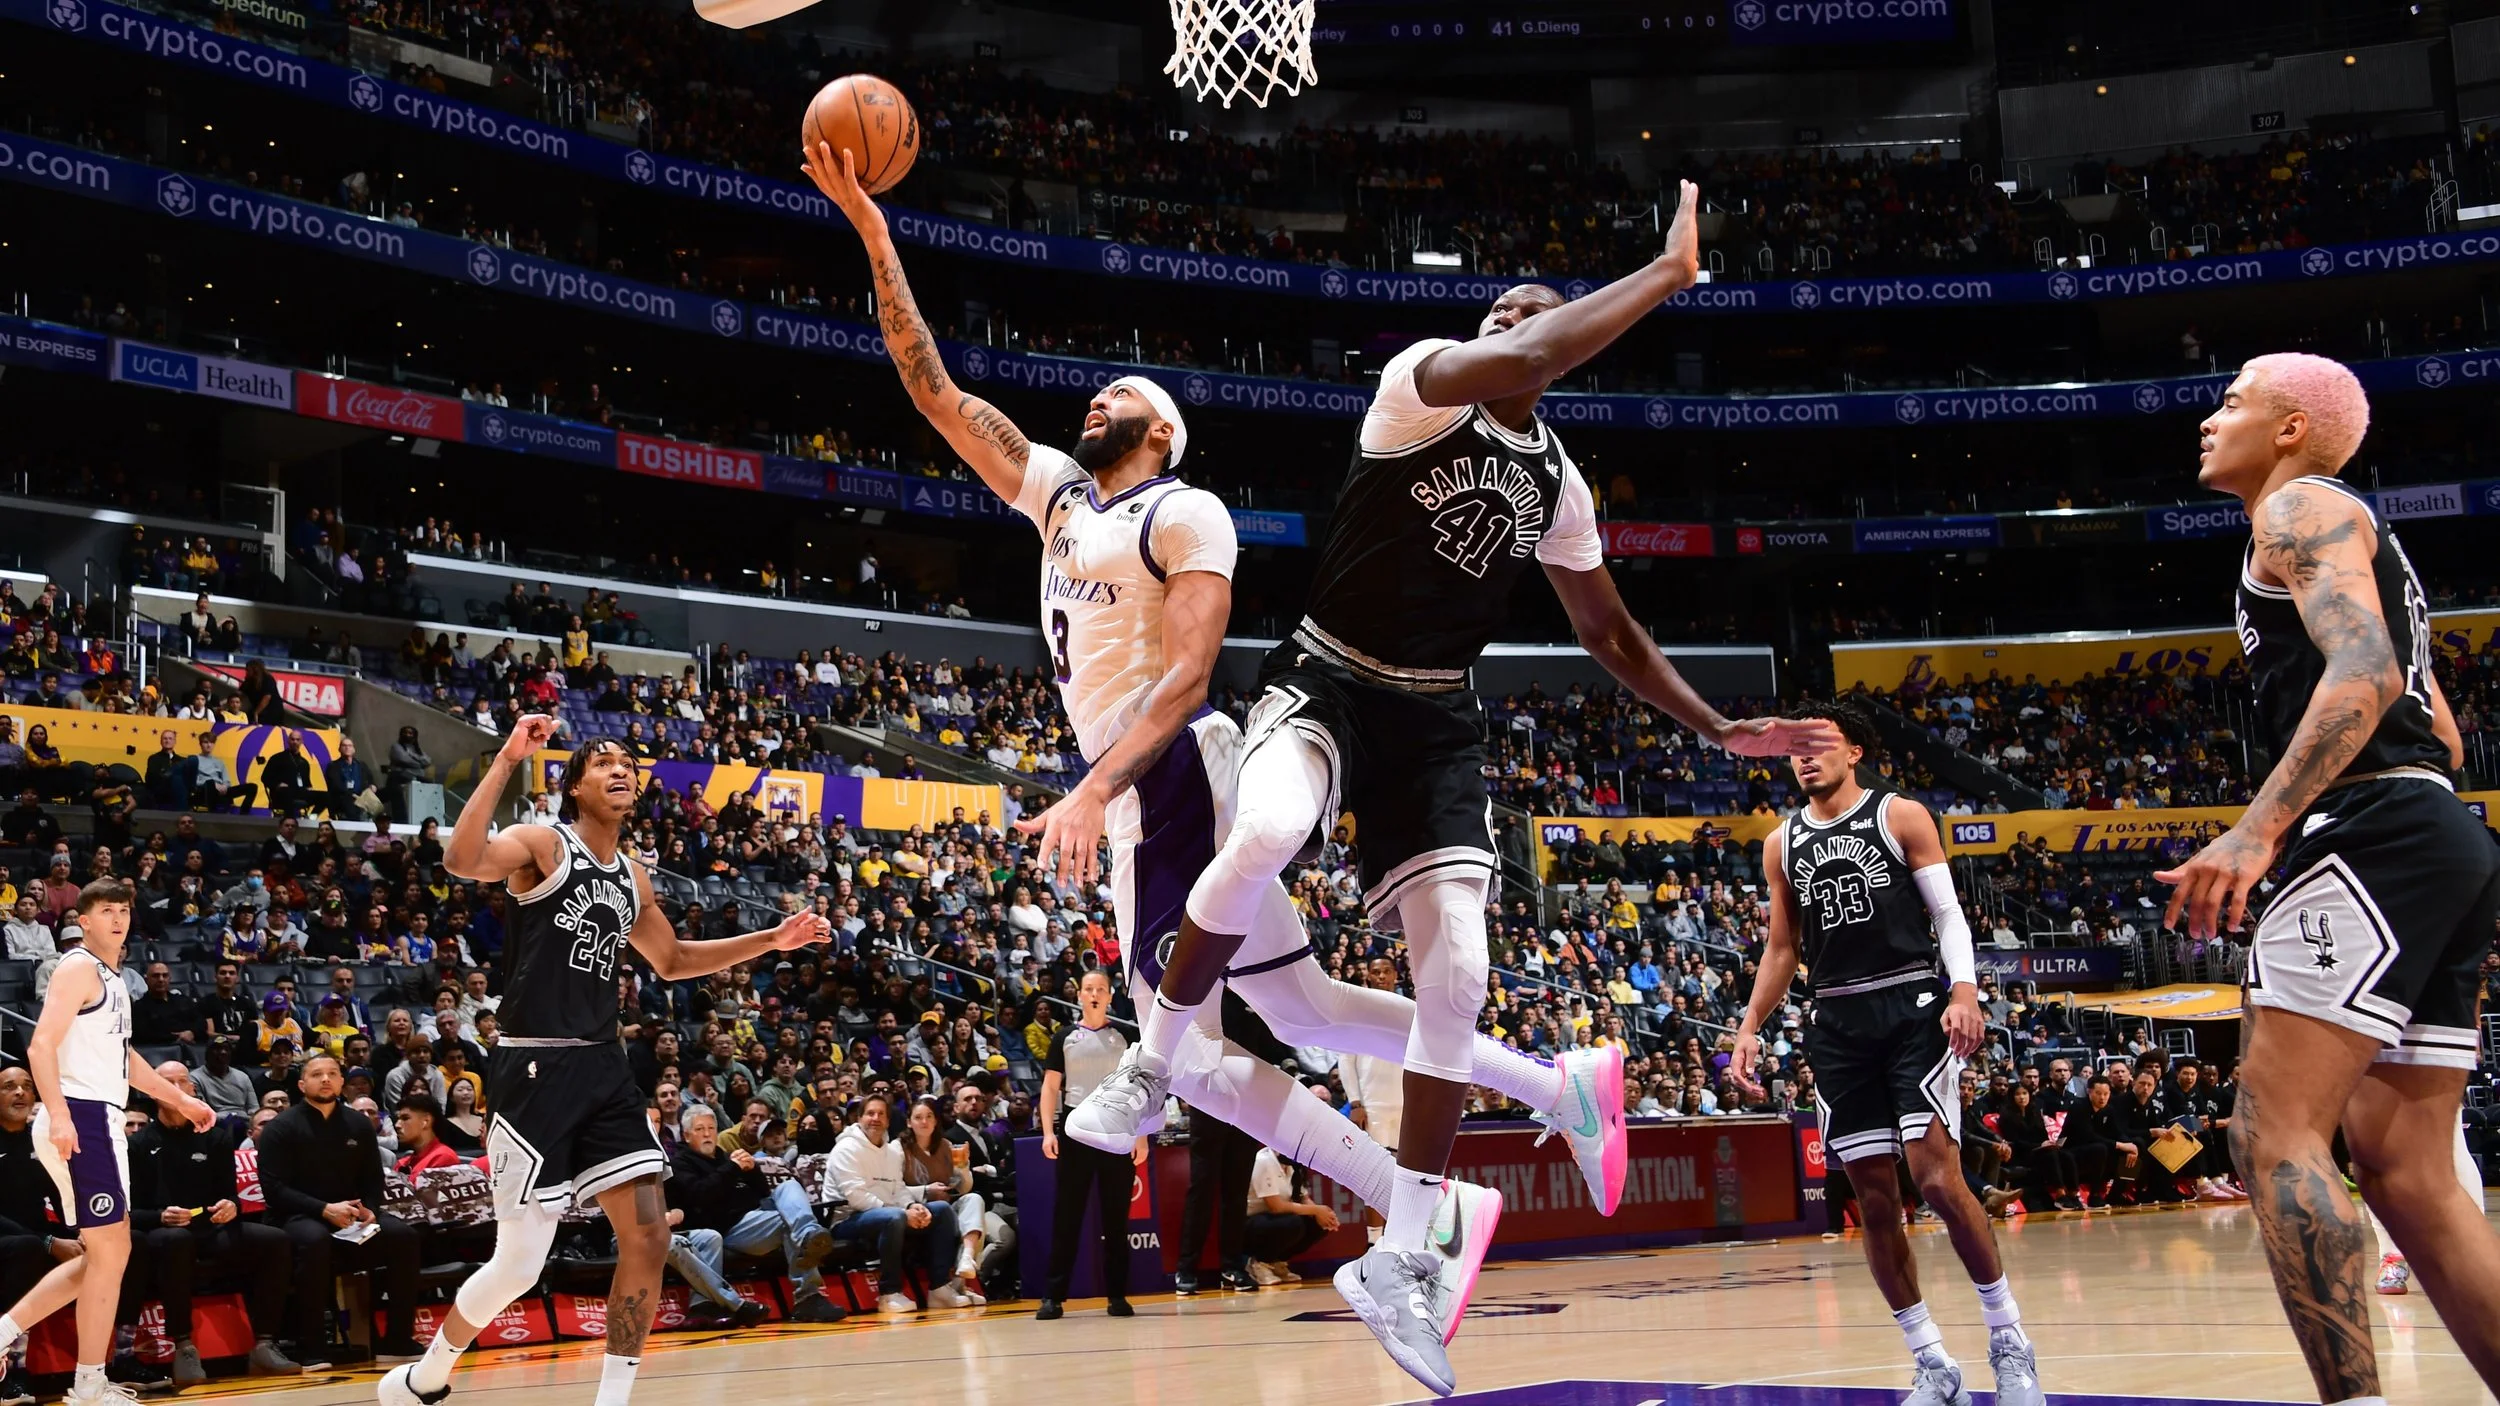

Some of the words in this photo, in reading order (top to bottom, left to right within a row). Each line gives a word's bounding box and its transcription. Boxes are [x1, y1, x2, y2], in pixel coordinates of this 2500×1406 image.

[211, 0, 306, 30] pectrum
[1492, 20, 1513, 36] 41
[1522, 19, 1580, 35] G.Dieng
[1642, 17, 1651, 30] 0
[1664, 17, 1671, 29] 1
[1684, 15, 1693, 29] 0
[1705, 14, 1715, 28] 0
[1776, 0, 1948, 23] crypto.com
[1391, 25, 1400, 37] 0
[1412, 24, 1421, 36] 0
[1433, 23, 1442, 36] 0
[1455, 23, 1464, 35] 0
[100, 10, 307, 89] crypto.com
[393, 92, 569, 160] crypto.com
[2257, 115, 2280, 129] 307
[665, 161, 830, 219] crypto.com
[208, 192, 404, 259] crypto.com
[899, 213, 1048, 261] crypto.com
[1139, 251, 1290, 289] crypto.com
[2088, 257, 2263, 295] crypto.com
[510, 259, 676, 320] crypto.com
[1830, 278, 1992, 305] crypto.com
[15, 336, 97, 362] EXPRESS
[132, 354, 189, 381] UCLA
[205, 366, 284, 400] Health
[1220, 382, 1367, 413] crypto.com
[1934, 393, 2097, 420] crypto.com
[1681, 400, 1840, 428] crypto.com
[510, 421, 601, 453] crypto.com
[623, 439, 755, 484] TOSHIBA
[838, 474, 896, 499] ULTRA
[1411, 456, 1475, 511] SAN
[1479, 456, 1544, 558] ANTONIO
[2384, 493, 2456, 515] Health
[1431, 499, 1513, 579] 41
[1616, 527, 1688, 553] Coca-Cola
[1767, 532, 1828, 546] TOYOTA
[1864, 529, 1930, 542] AMERICAN
[1933, 526, 1991, 540] EXPRESS
[1044, 565, 1123, 606] ANGELES
[1052, 608, 1072, 684] 3
[2115, 646, 2213, 674] LOS
[1849, 818, 1874, 830] Self.
[1955, 825, 1991, 843] 105
[2105, 822, 2137, 834] LOS
[1794, 858, 1816, 907] SAN
[1813, 834, 1891, 888] ANTONIO
[553, 883, 593, 931] SAN
[591, 879, 633, 948] ANTONIO
[1811, 872, 1874, 931] 33
[569, 918, 620, 981] 24
[2032, 958, 2089, 974] ULTRA
[1548, 1155, 1704, 1208] HYATION.
